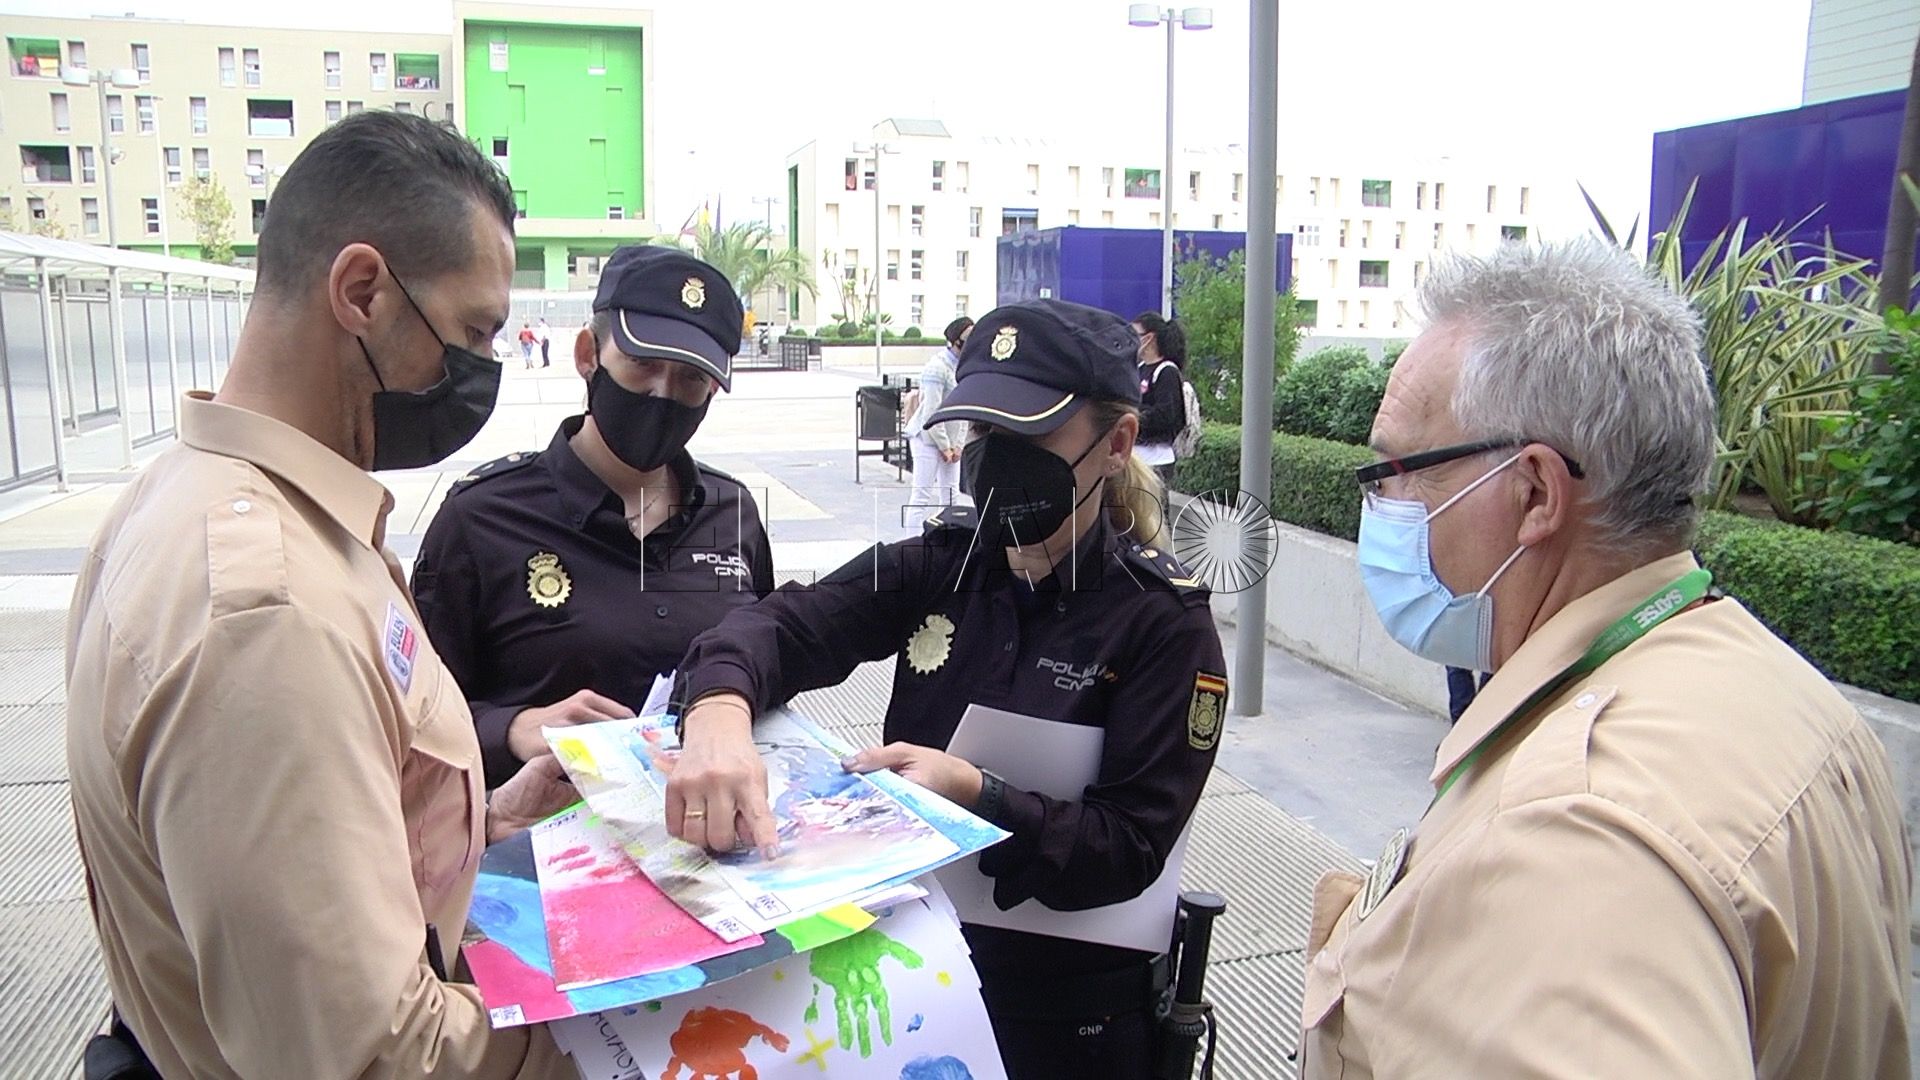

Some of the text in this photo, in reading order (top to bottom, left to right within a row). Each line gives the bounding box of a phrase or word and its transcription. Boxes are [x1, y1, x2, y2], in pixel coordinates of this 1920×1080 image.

[692, 553, 752, 576] POLIC
[1632, 588, 1684, 629] SATSE
[1054, 676, 1095, 691] CNP
[1078, 1024, 1104, 1036] CNP
